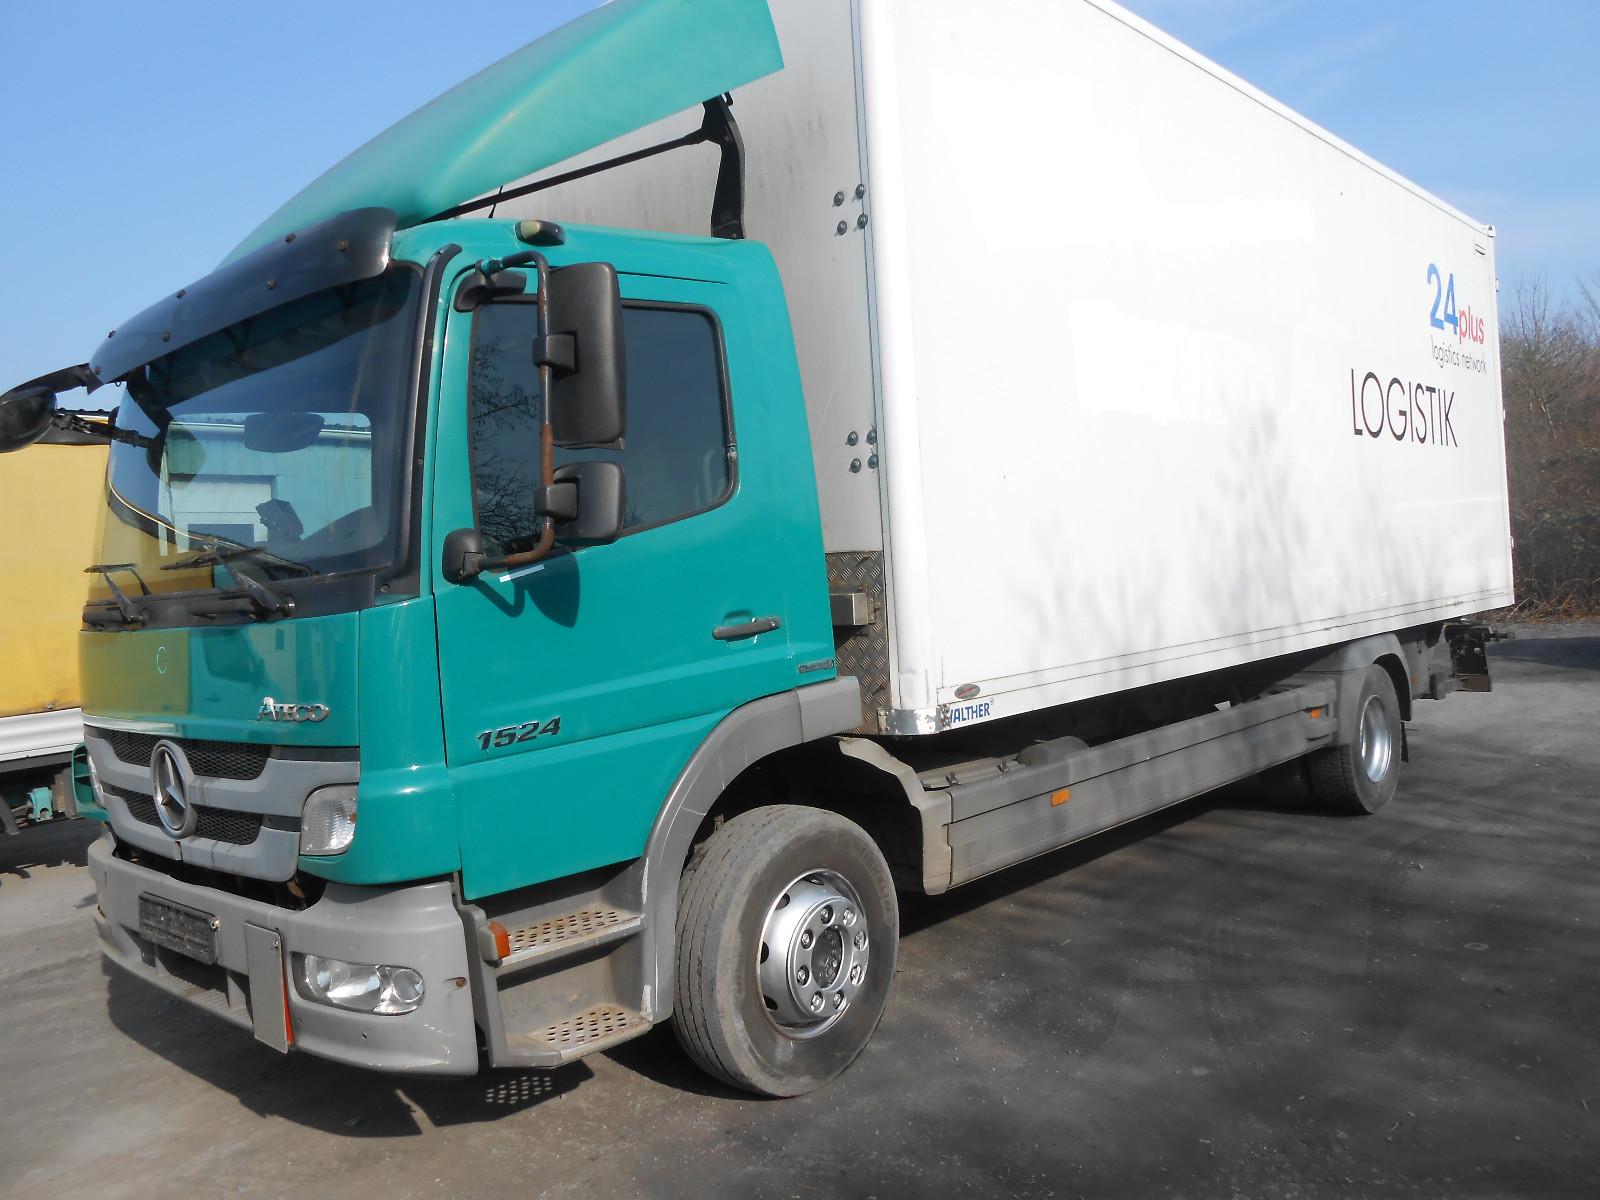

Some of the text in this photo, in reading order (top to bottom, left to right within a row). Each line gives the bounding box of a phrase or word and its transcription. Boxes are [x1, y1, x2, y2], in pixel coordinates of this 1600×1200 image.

[1430, 334, 1487, 376] logistics network
[1351, 368, 1458, 447] LOGISTIK
[478, 717, 560, 751] 1524
